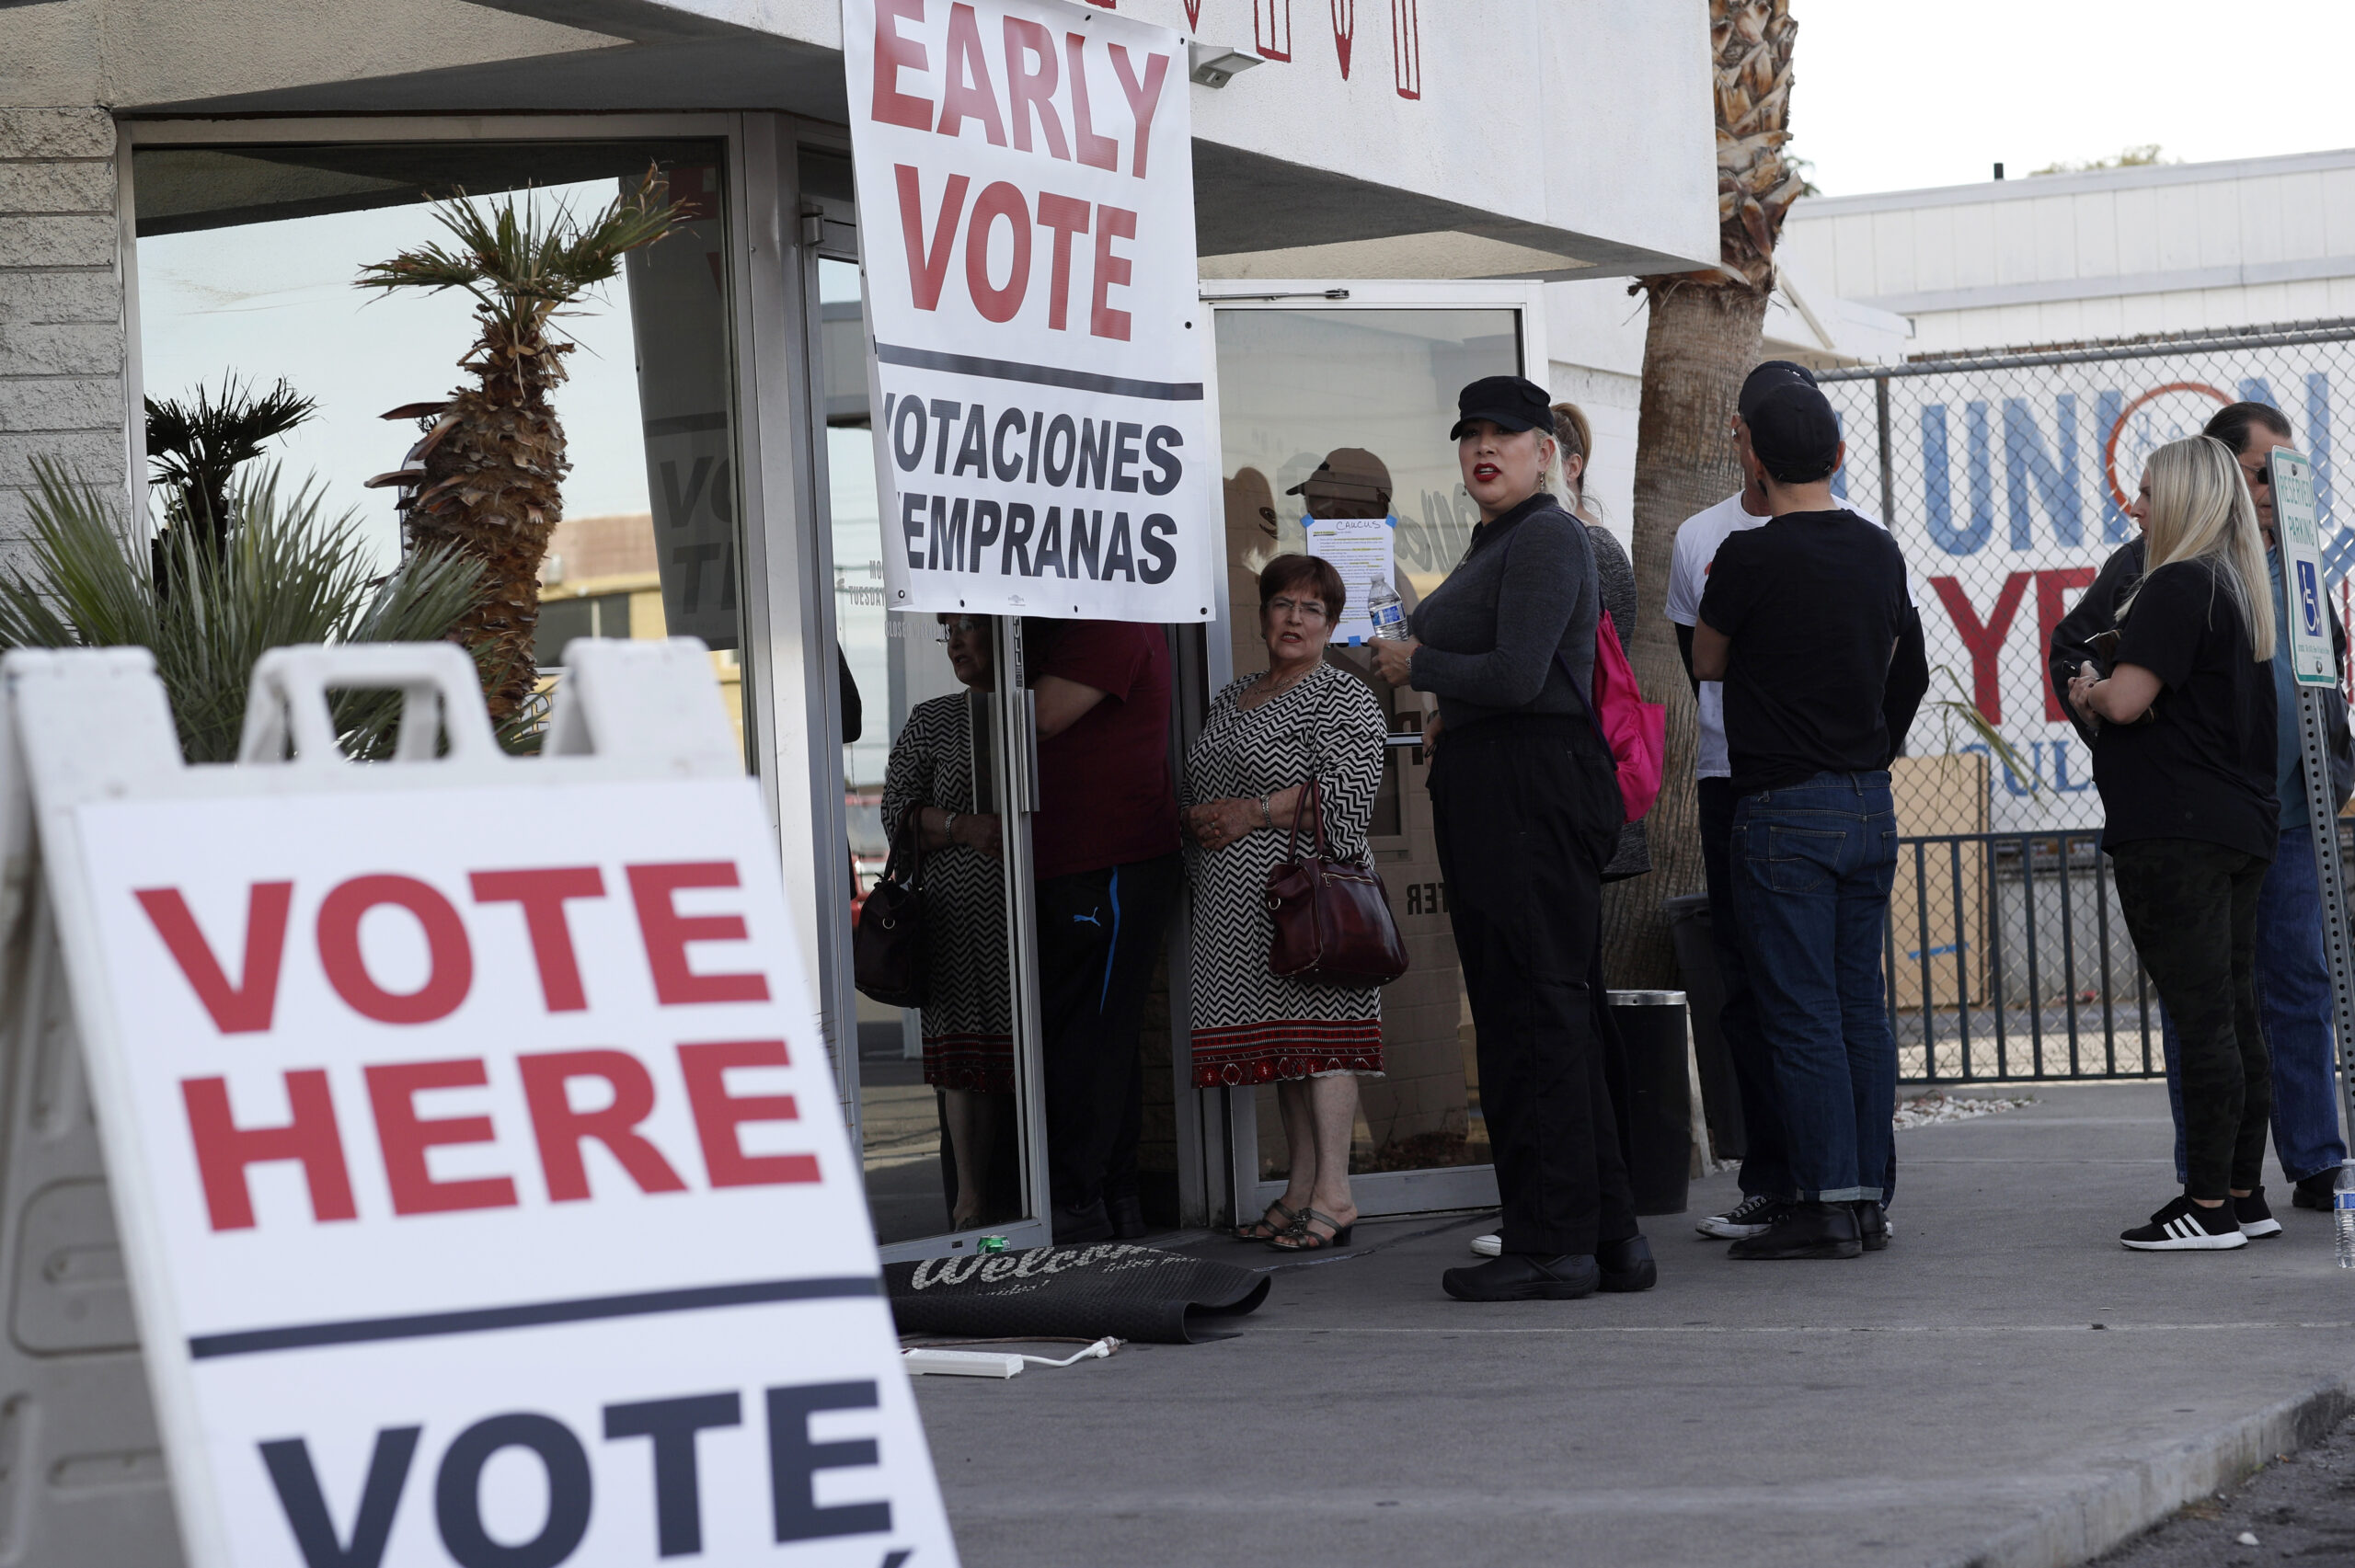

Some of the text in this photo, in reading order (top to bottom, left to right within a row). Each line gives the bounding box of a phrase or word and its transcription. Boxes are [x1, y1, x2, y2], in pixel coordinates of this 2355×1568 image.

[871, 0, 1169, 179] EARLY
[894, 164, 1137, 342] VOTE
[2279, 475, 2313, 509] RESERVED
[898, 491, 1178, 586] EMPRANAS
[2288, 515, 2315, 547] PARKING
[848, 585, 887, 607] TUESDAY
[869, 559, 885, 580] MO
[884, 620, 912, 638] CLOSED
[133, 860, 772, 1036] VOTE
[180, 1038, 822, 1233] HERE
[910, 1242, 1186, 1291] Welcom
[258, 1379, 893, 1568] VOTE
